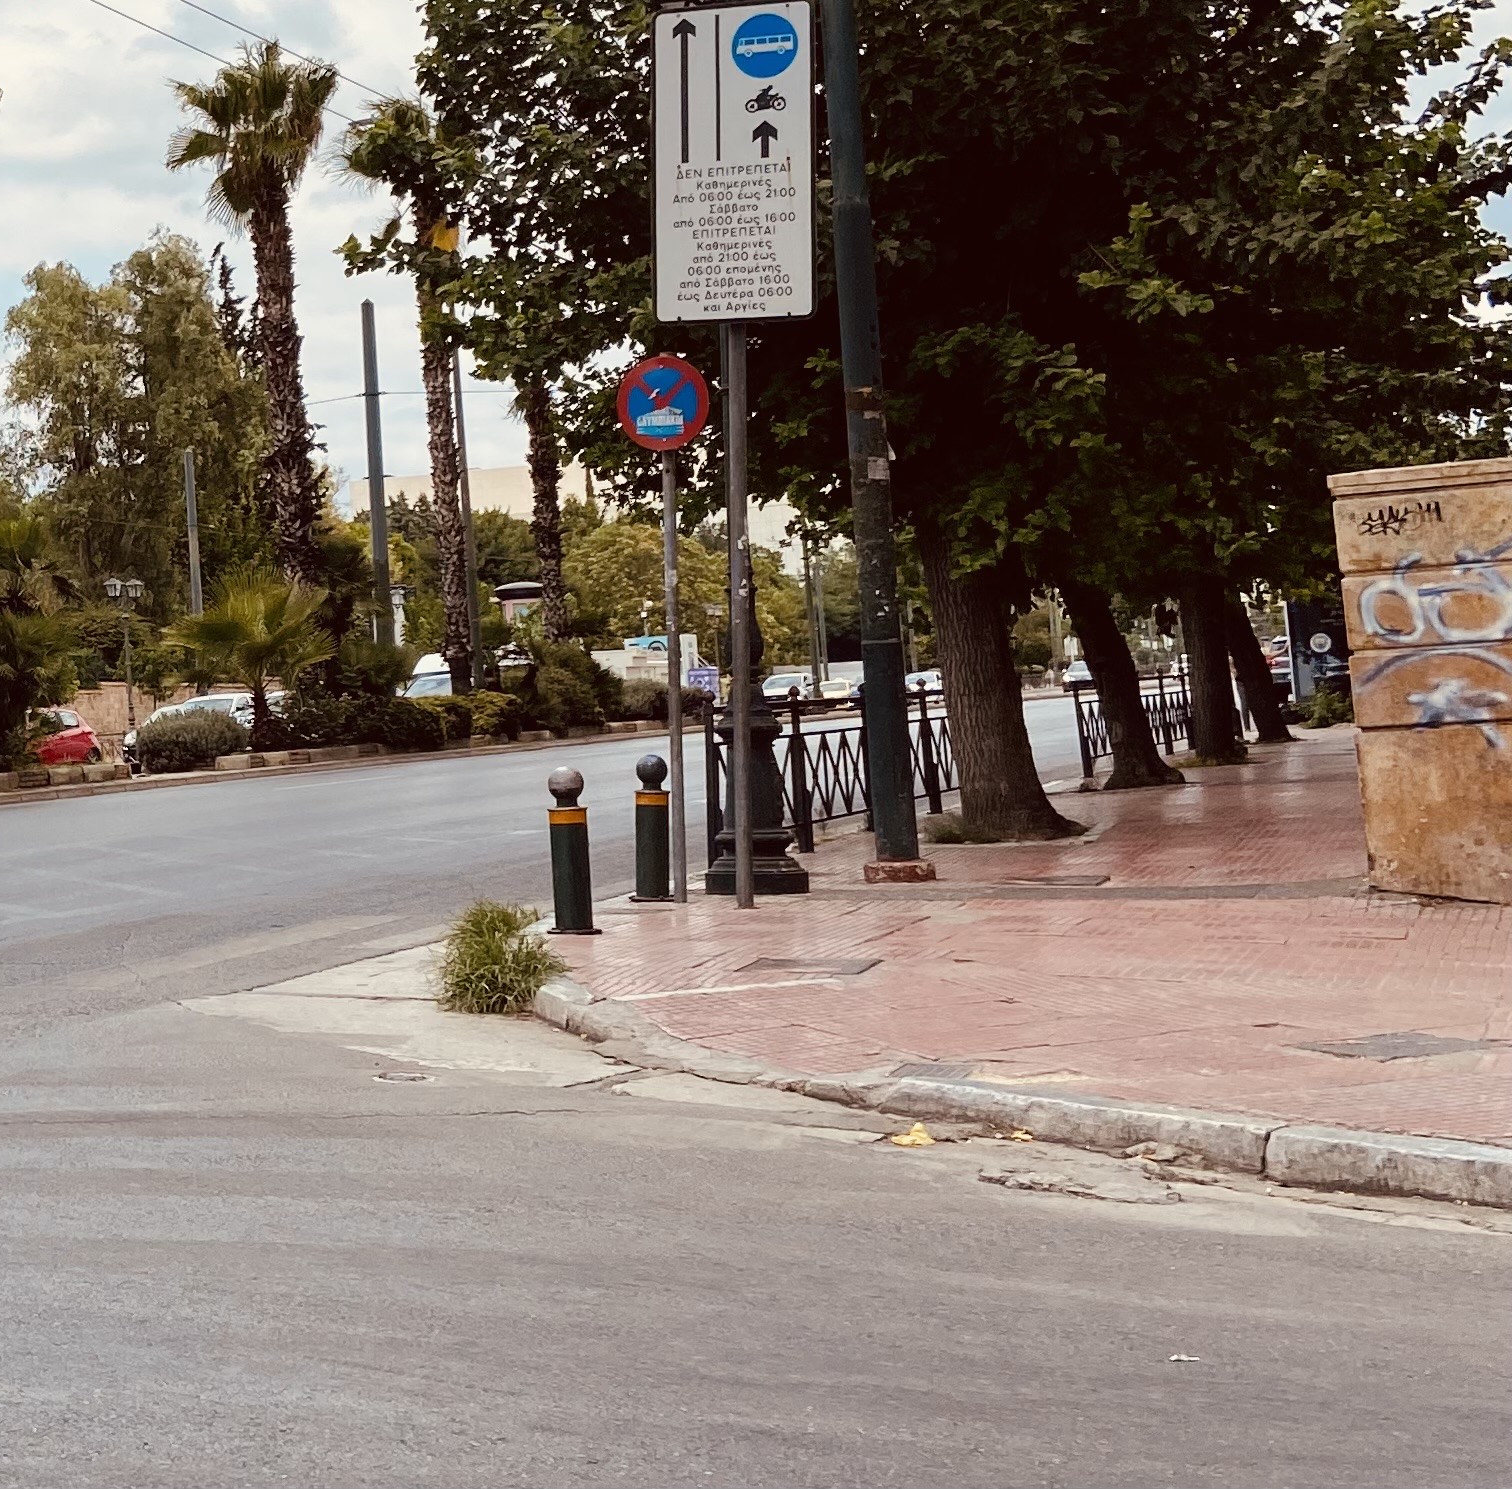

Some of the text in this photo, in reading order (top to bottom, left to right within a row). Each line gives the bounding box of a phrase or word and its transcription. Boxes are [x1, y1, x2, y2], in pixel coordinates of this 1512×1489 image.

[677, 162, 791, 180] ΔΕΝ ΕΠΙΤΡΕΠΕΤΑΙ
[697, 176, 772, 190] Καθημερινές
[673, 194, 694, 204] Από
[738, 190, 760, 200] έως
[709, 203, 758, 214] Σάββατο
[673, 218, 694, 228] από
[737, 215, 760, 225] έως
[693, 226, 776, 239] ΕΠΙΤΡΕΠΕΤΑΙ
[697, 238, 772, 252] Καθημερινές
[693, 254, 713, 264] από
[753, 250, 776, 261] έως
[726, 262, 782, 274] επομένης
[680, 278, 700, 288] από
[705, 276, 754, 287] Σάββατο
[677, 292, 700, 302] έως
[705, 289, 753, 300] Δευτέρα
[703, 300, 766, 313] και Αργίες
